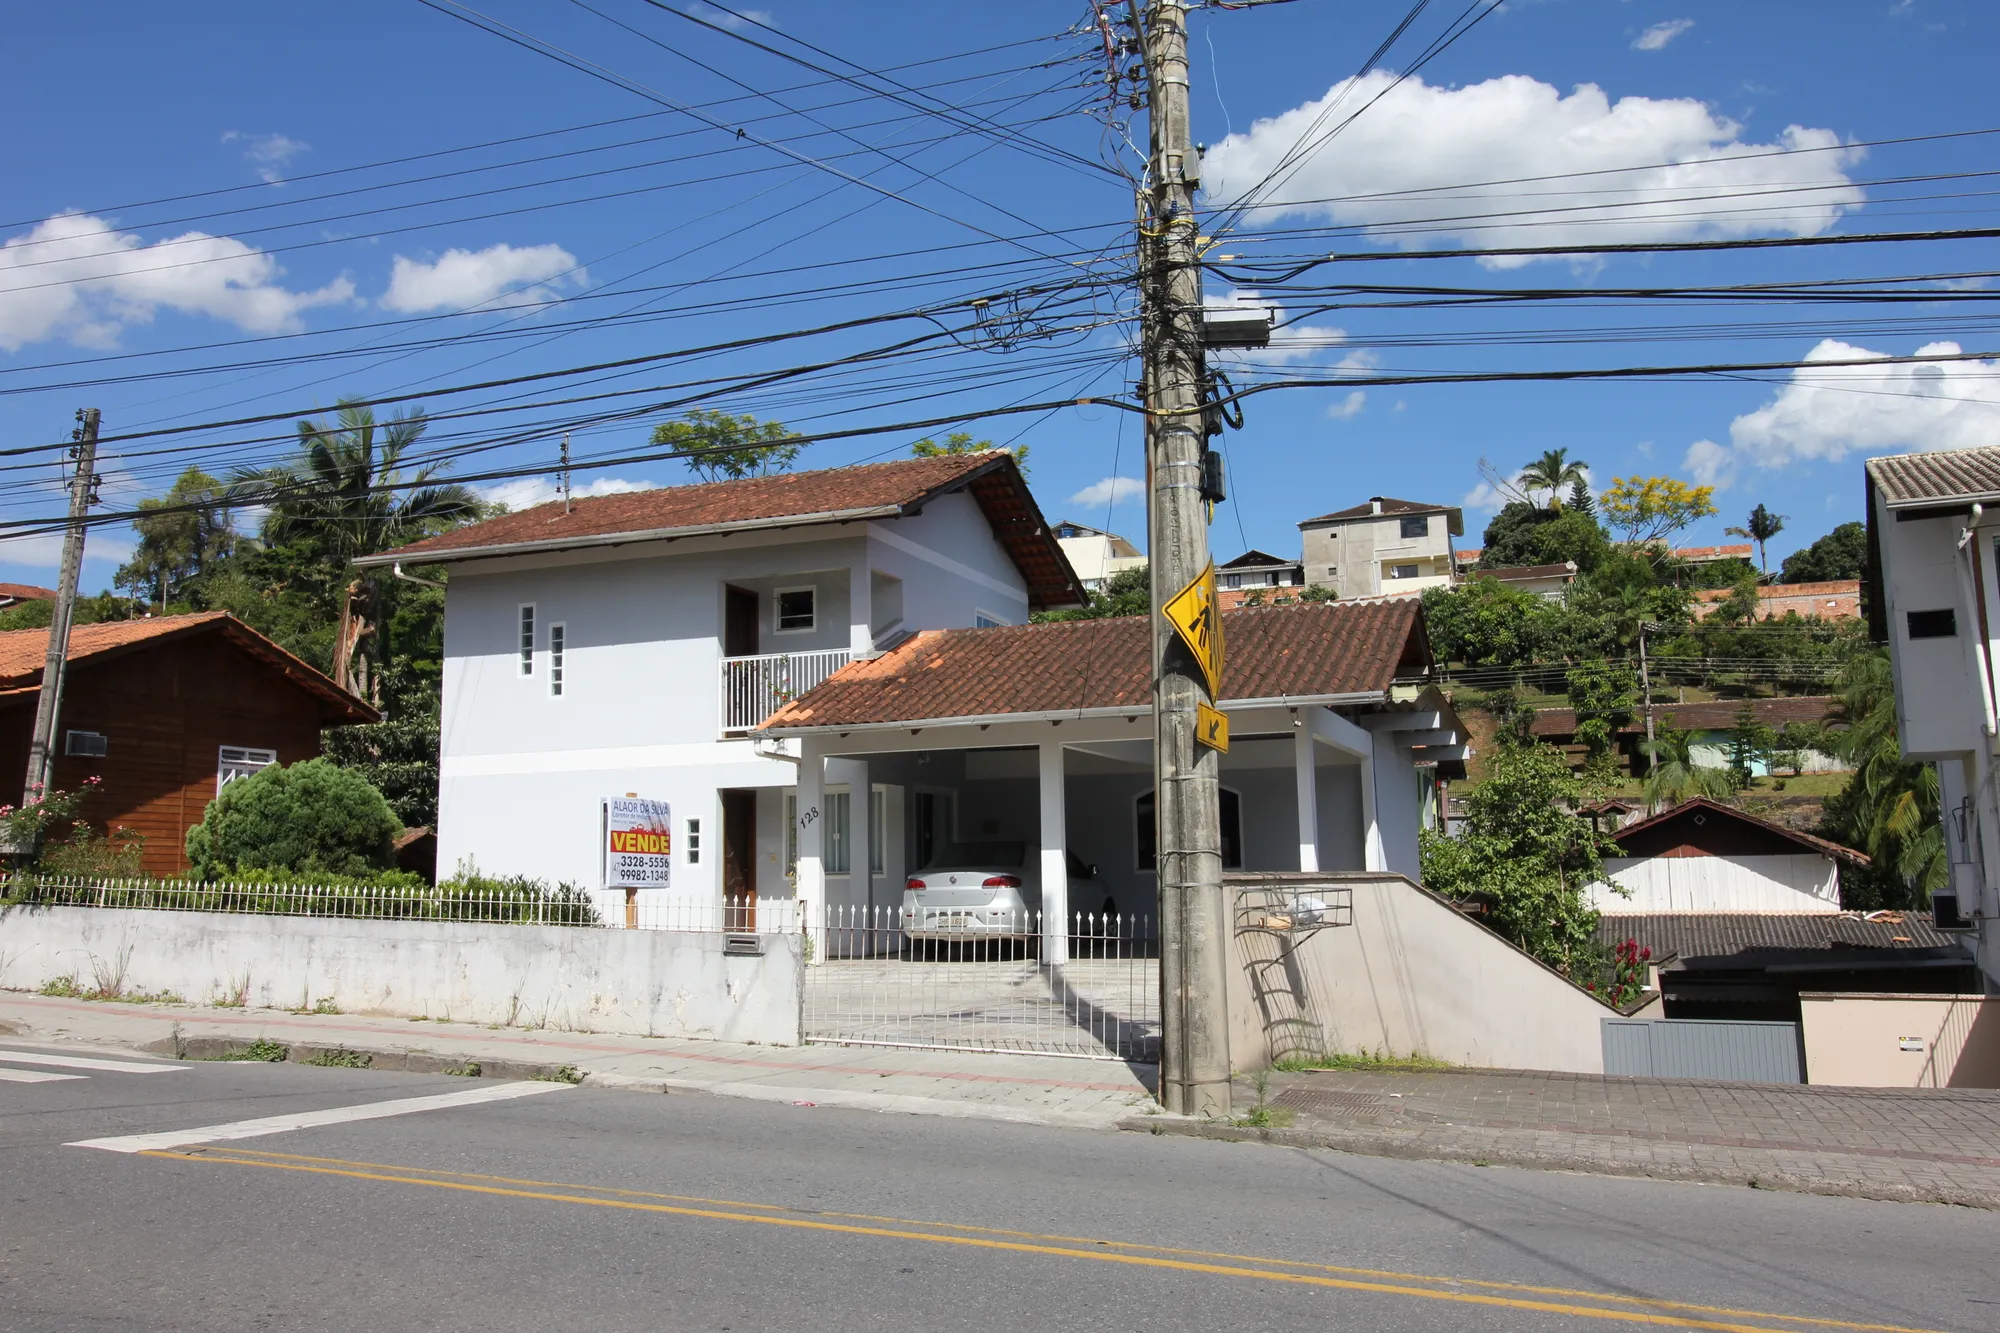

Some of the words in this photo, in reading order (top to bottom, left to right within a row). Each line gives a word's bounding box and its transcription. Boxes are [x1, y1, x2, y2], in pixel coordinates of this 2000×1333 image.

[613, 801, 638, 813] ALAOR
[640, 803, 650, 814] DA
[651, 804, 668, 816] SILVA
[800, 806, 819, 829] 128
[612, 832, 670, 854] VENDE
[620, 856, 670, 868] 3328-5556
[620, 869, 669, 882] 99982-1348
